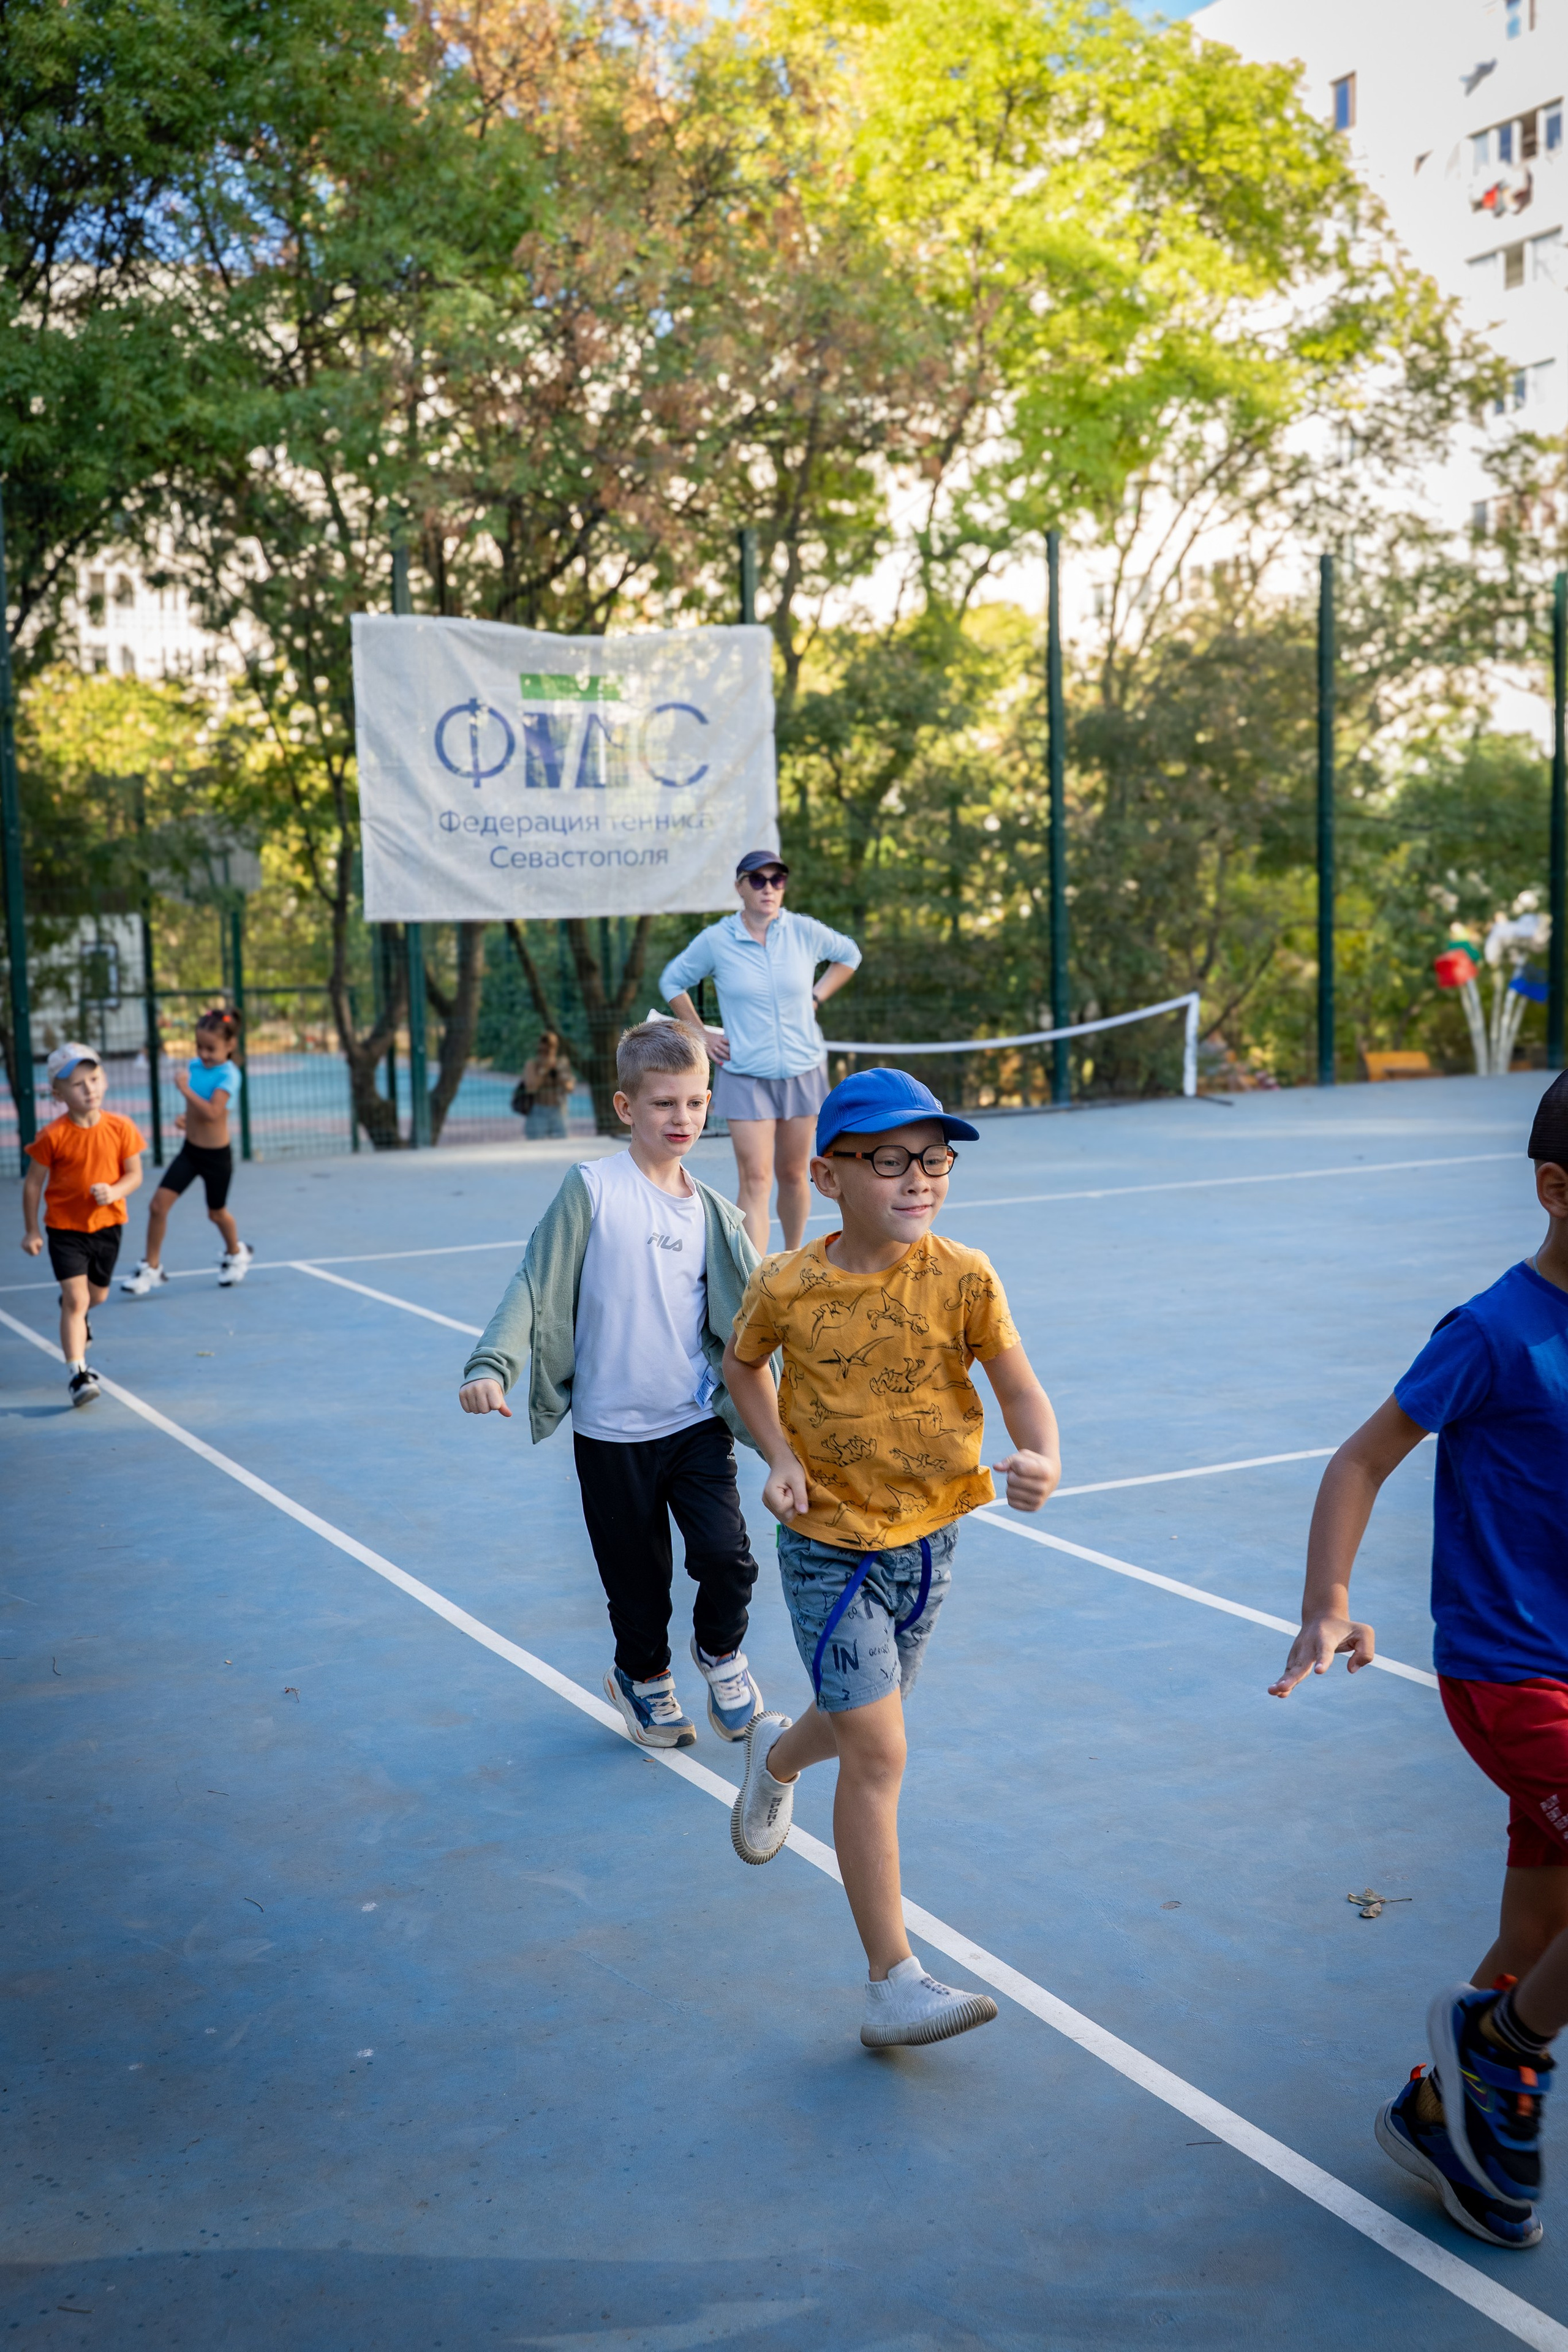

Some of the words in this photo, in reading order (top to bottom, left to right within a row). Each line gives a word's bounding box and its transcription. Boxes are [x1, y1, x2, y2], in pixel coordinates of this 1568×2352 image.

[439, 810, 599, 837] Федерация
[490, 845, 668, 869] Севастополя
[647, 1232, 682, 1251] FILA
[832, 1639, 859, 1675] IN
